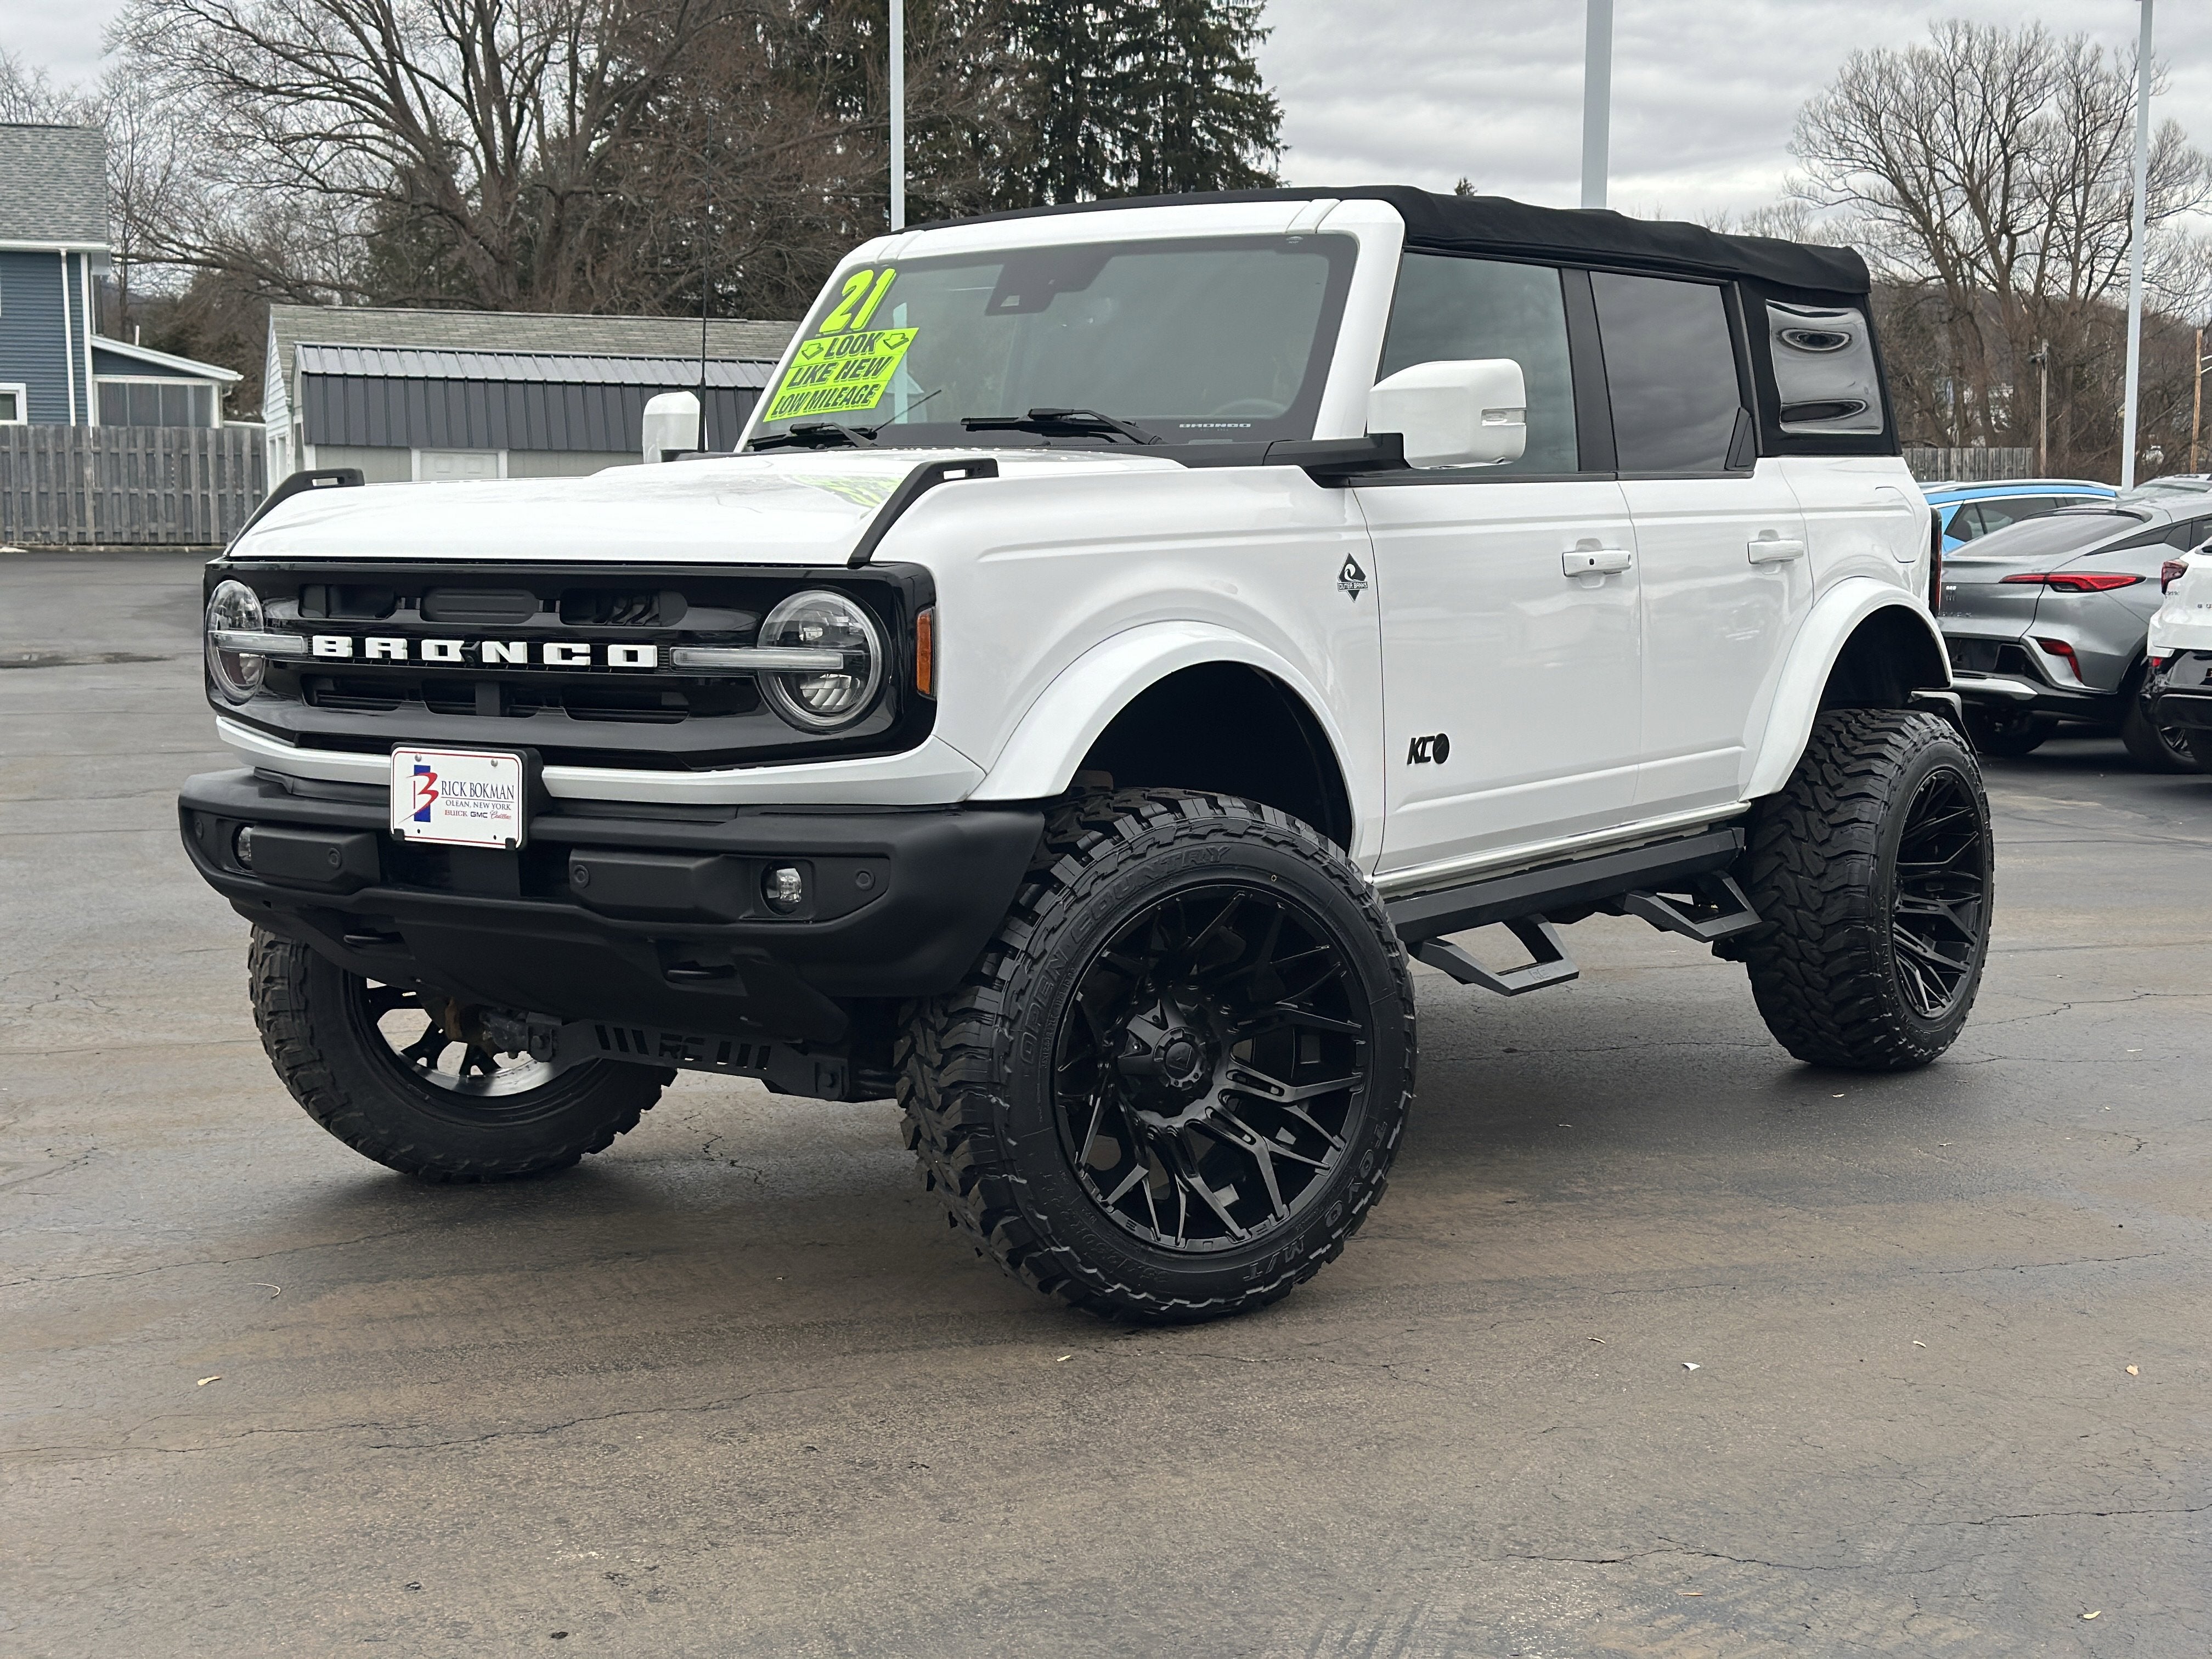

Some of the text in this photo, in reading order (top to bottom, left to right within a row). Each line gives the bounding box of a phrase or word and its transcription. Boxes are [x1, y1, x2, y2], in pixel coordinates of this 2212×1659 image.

[819, 269, 896, 332] 21
[824, 332, 884, 360] LOOK
[787, 356, 894, 390] LIKE NEW
[771, 384, 879, 418] LOW MILEAGE
[313, 635, 657, 668] BRONCO
[441, 781, 514, 800] RICK BOKMAN
[445, 799, 472, 808] OLEAN,
